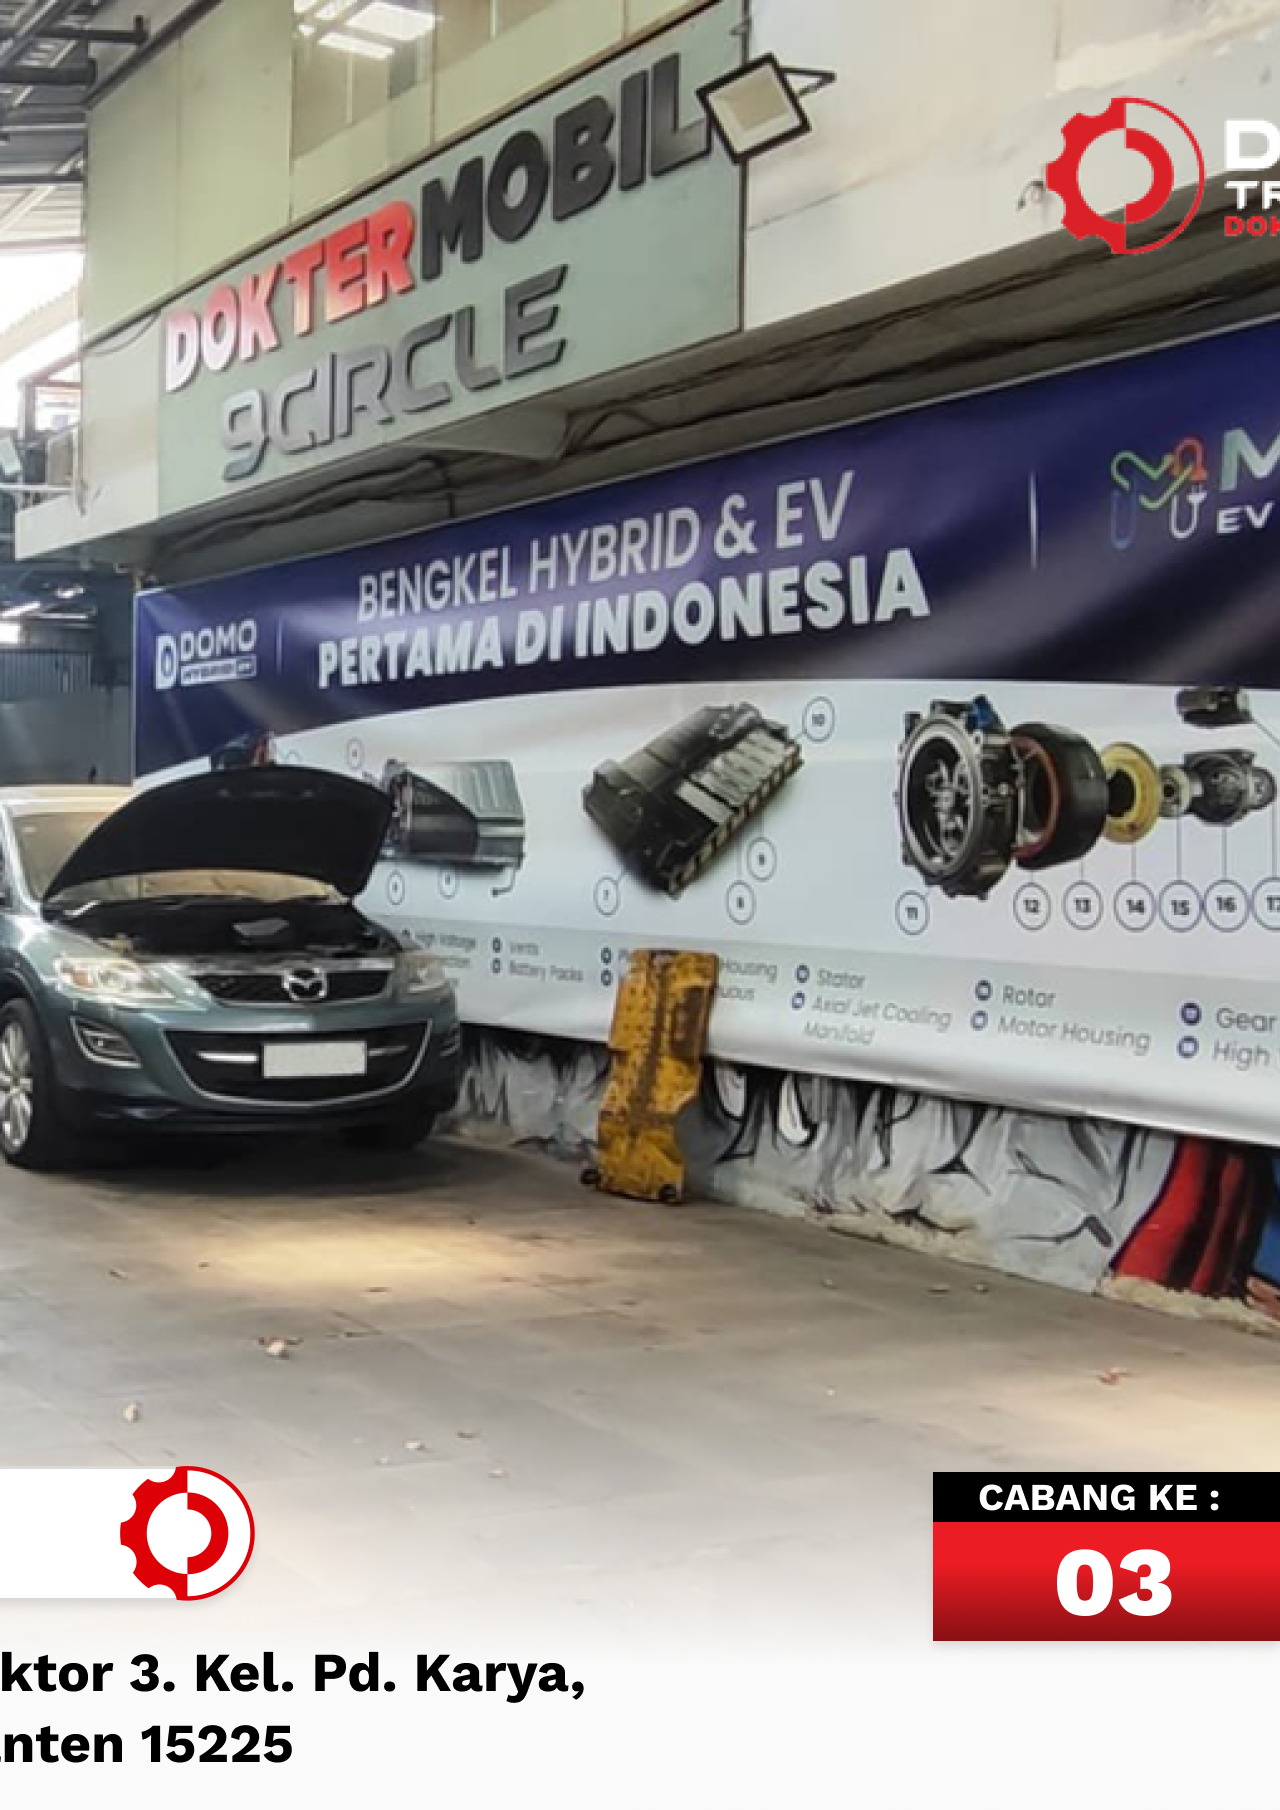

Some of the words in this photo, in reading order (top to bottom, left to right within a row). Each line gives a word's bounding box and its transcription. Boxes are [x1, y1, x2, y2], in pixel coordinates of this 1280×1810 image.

[1217, 501, 1274, 534] EV
[357, 545, 517, 623] BENGKEL
[528, 507, 701, 594] HYBRID
[713, 493, 757, 559] &
[775, 469, 855, 551] EV
[318, 613, 503, 690] PERTAMA
[513, 609, 563, 665] DI
[574, 547, 930, 658] INDONESIA
[180, 618, 258, 662] DOMO
[905, 906, 919, 921] 11
[1023, 898, 1040, 914] 12
[1074, 897, 1092, 914] 13
[1125, 898, 1146, 914] 14
[1171, 898, 1190, 916] 15
[1215, 895, 1237, 913] 16
[817, 968, 866, 988] Stator
[1002, 985, 1056, 1008] Rotor
[812, 995, 852, 1014] Axial
[852, 1000, 880, 1018] Jet
[883, 1002, 953, 1033] Cooling
[1216, 1007, 1277, 1032] Gear
[805, 1020, 876, 1044] Manifold
[998, 1015, 1058, 1038] Motor
[1060, 1021, 1152, 1057] Housing
[1211, 1039, 1270, 1072] High
